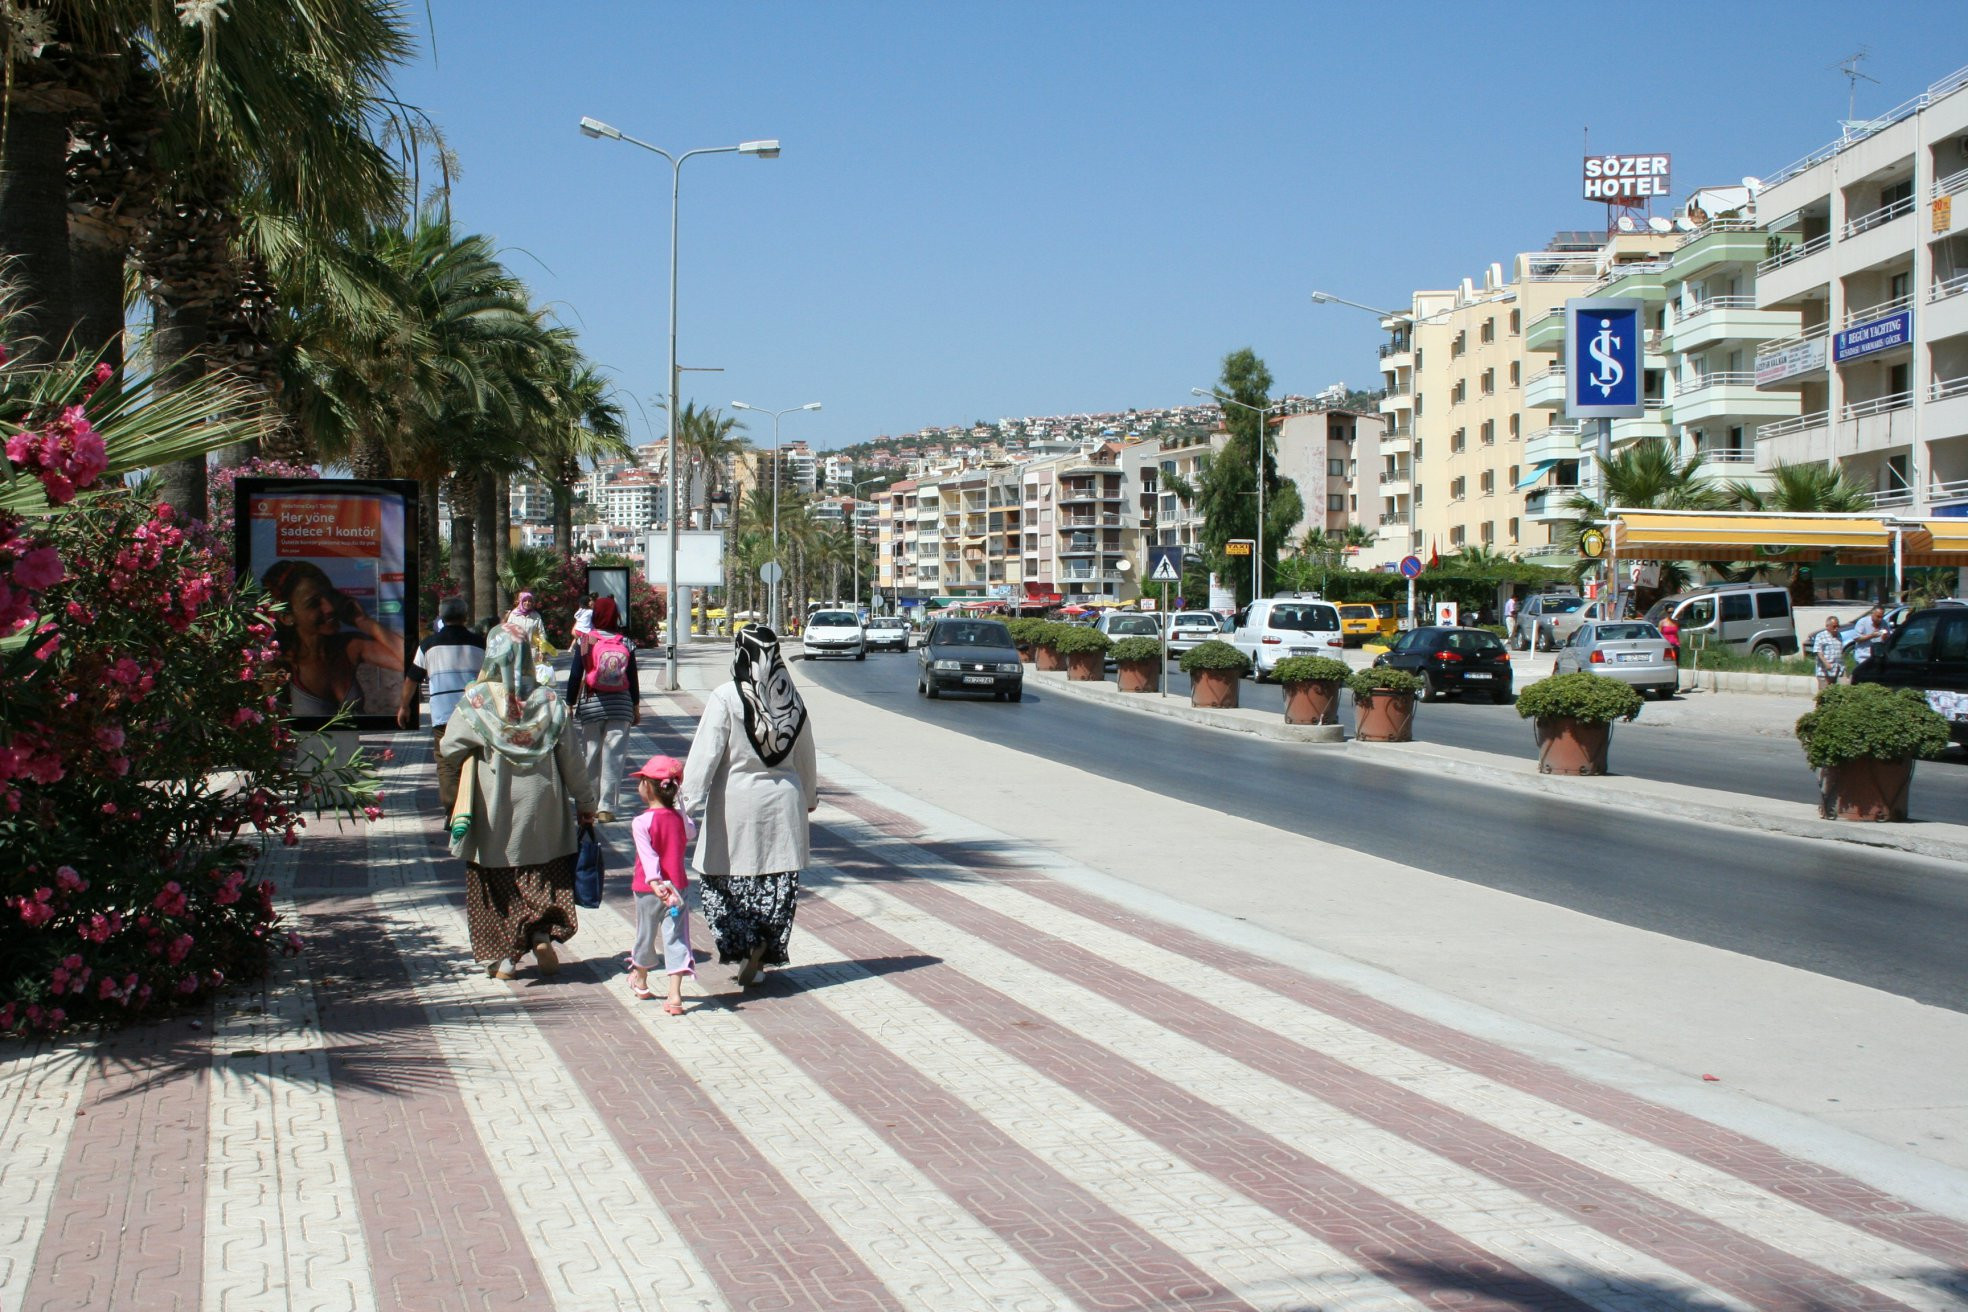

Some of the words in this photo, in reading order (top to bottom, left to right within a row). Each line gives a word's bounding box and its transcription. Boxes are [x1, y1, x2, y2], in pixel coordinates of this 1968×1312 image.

[1585, 155, 1668, 177] SÖZER
[1584, 177, 1667, 197] HOTEL
[1870, 318, 1901, 337] YACHTING
[281, 512, 302, 523] Her
[305, 512, 335, 524] yöne
[281, 527, 323, 536] sadece
[327, 527, 332, 536] 1
[336, 526, 376, 536] kontör
